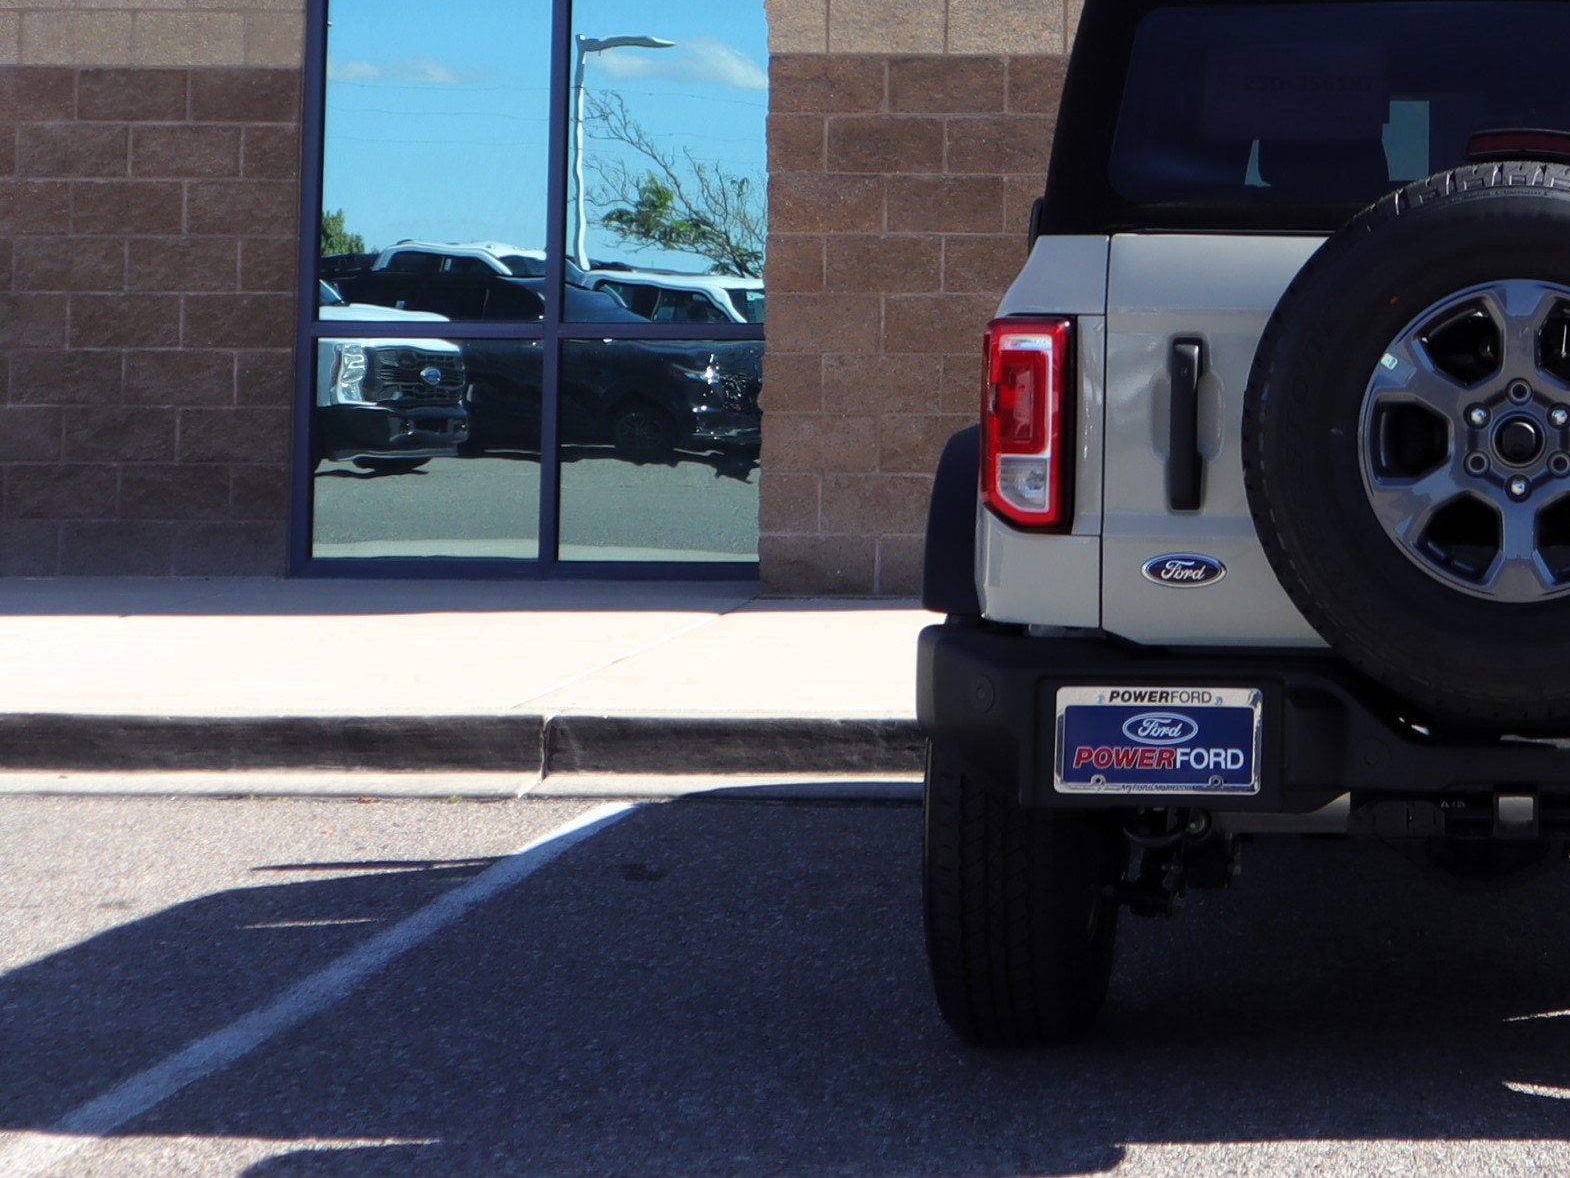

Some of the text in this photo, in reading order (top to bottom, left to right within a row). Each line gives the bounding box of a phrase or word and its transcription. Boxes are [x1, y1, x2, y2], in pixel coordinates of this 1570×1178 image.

[1160, 559, 1207, 581] Ford
[1108, 690, 1213, 704] POWERFORD
[1137, 717, 1183, 738] Ford
[1073, 746, 1245, 770] POWERFORD
